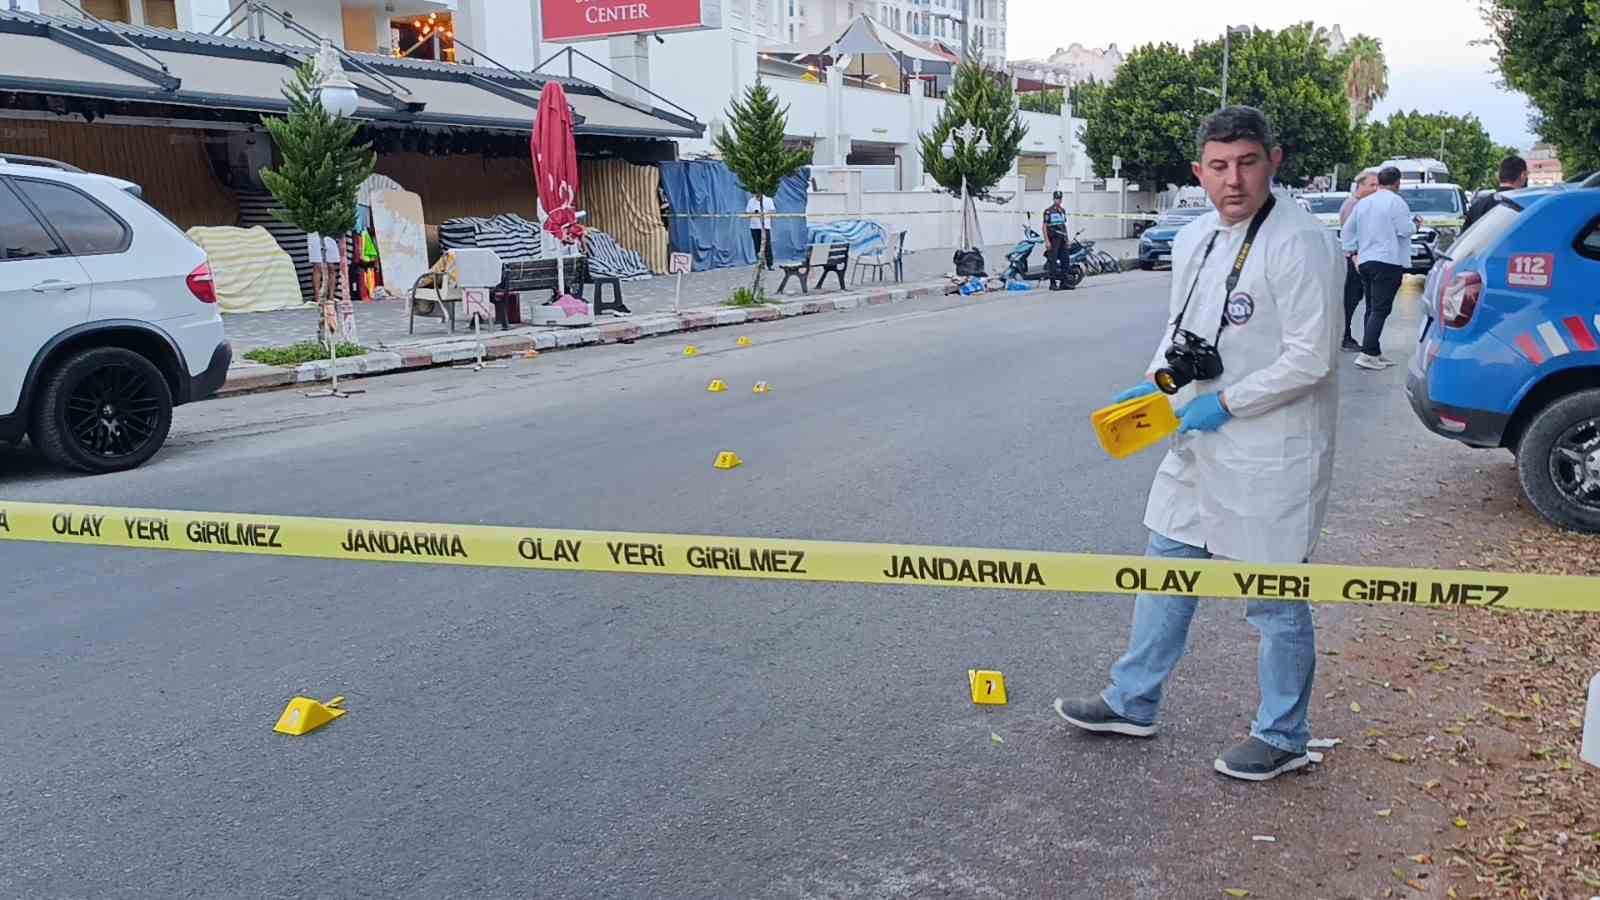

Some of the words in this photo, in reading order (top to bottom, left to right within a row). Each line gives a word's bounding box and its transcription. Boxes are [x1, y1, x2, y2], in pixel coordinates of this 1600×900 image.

[585, 3, 649, 24] CENTER
[1514, 256, 1545, 273] 112
[52, 512, 103, 537] OLAY
[341, 529, 468, 558] JANDARMA
[518, 537, 581, 562] OLAY
[883, 555, 1046, 586] JANDARMA
[1115, 567, 1201, 592] OLAY
[985, 679, 993, 695] 7
